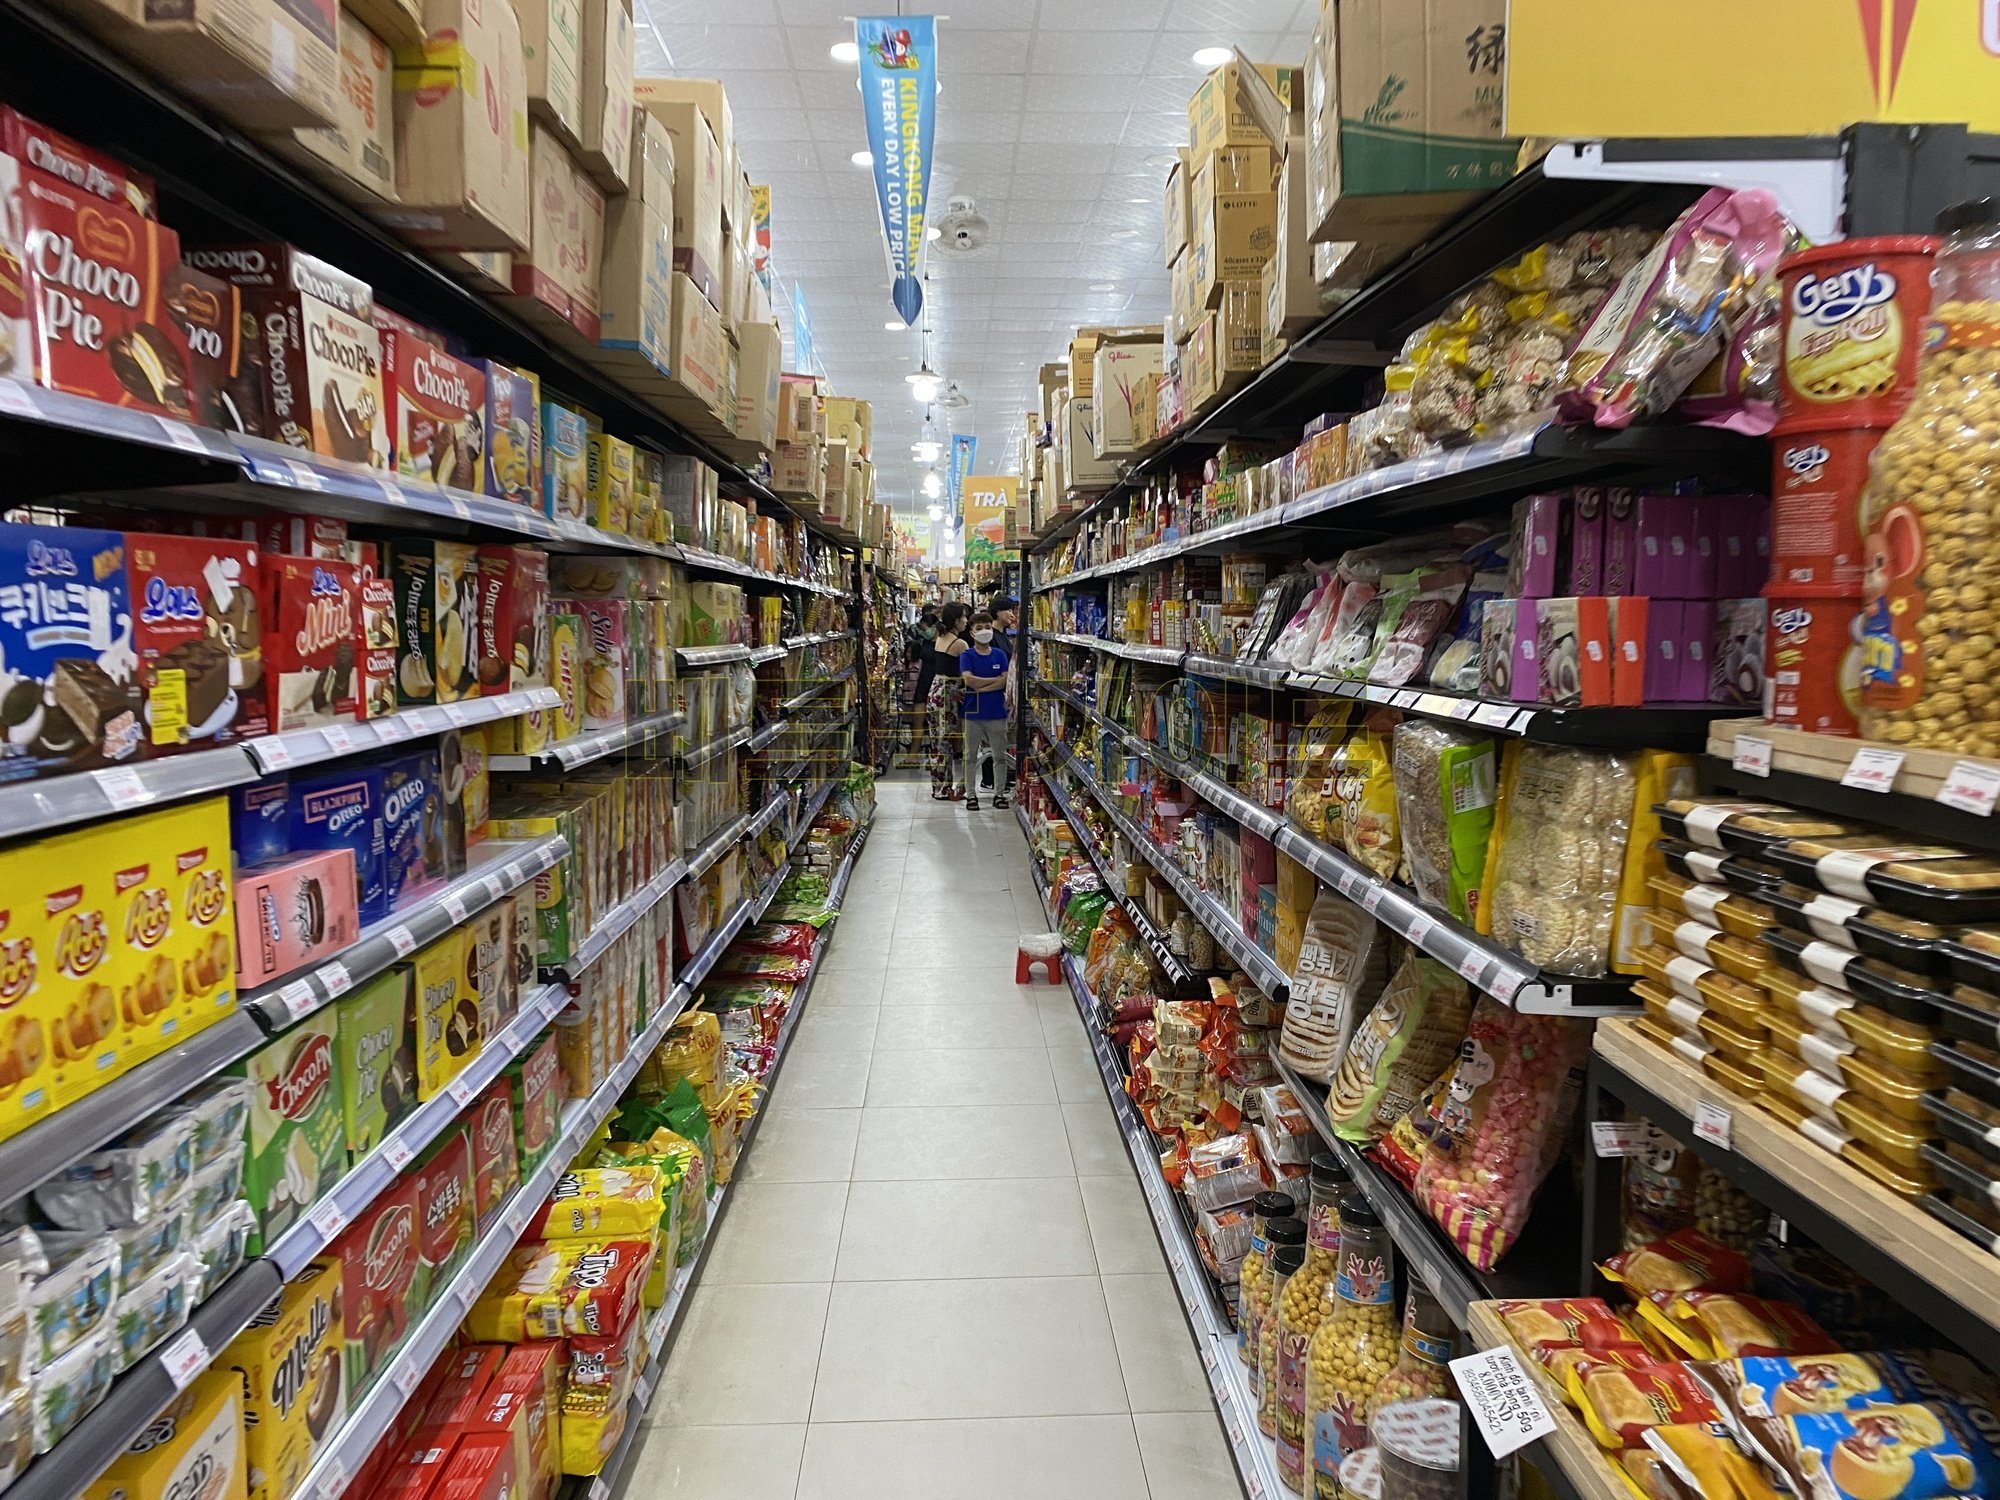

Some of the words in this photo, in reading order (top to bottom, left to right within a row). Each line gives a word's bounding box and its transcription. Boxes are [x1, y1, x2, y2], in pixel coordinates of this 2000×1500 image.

[880, 78, 899, 136] EVERY
[26, 136, 86, 188] Choco
[85, 163, 116, 200] Pie
[884, 140, 901, 178] DAY
[899, 77, 923, 208] KINGKONG
[887, 181, 904, 224] LOW
[32, 230, 140, 308] Choco
[889, 228, 906, 281] PRICE
[45, 287, 104, 351] Pie
[1791, 262, 1897, 325] Gery
[265, 313, 296, 418] ChocoPie
[310, 322, 377, 379] ChocoPie
[413, 356, 471, 411] ChocoPie
[587, 441, 600, 492] Custas
[1782, 444, 1830, 473] Gery
[972, 488, 1009, 508] TRÀ
[1772, 607, 1813, 634] Gery
[558, 652, 575, 724] Solite
[328, 804, 363, 833] OREO
[384, 779, 424, 825] OREO
[572, 1208, 584, 1232] Tipo
[571, 1249, 618, 1289] Tipo
[583, 1299, 600, 1331] Tipo
[1498, 1353, 1516, 1374] Kinh
[1476, 1368, 1515, 1423] 8.000VND
[1513, 1409, 1535, 1434] 50g
